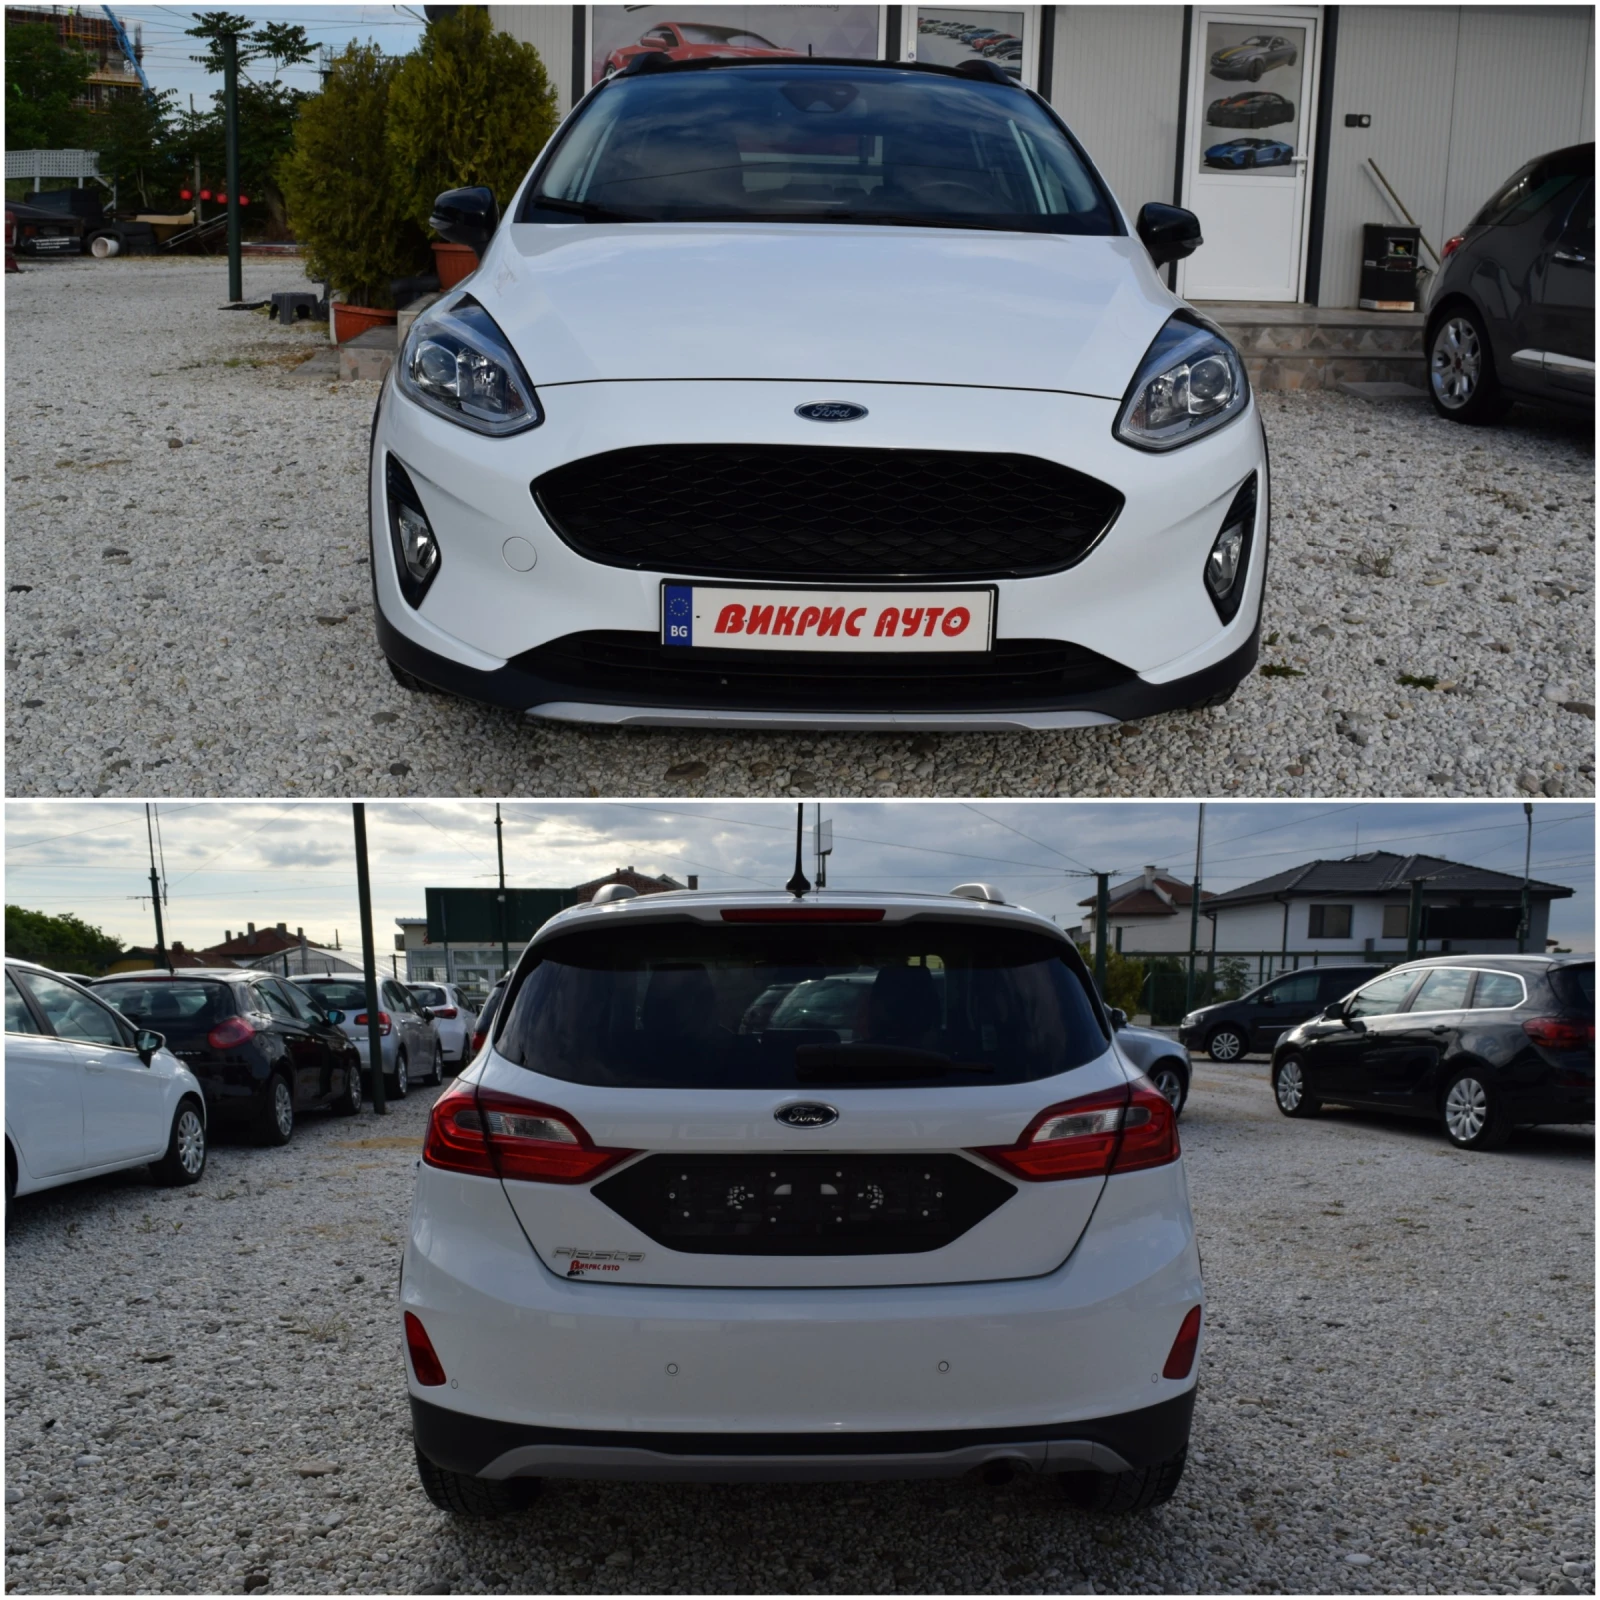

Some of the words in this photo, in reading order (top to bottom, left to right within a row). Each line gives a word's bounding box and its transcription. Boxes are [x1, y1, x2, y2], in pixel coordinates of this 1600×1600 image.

[811, 404, 850, 418] Ford
[714, 603, 867, 637] ВИКРИС
[873, 606, 971, 637] АУТО
[670, 625, 688, 637] BG
[788, 1107, 824, 1122] Ford
